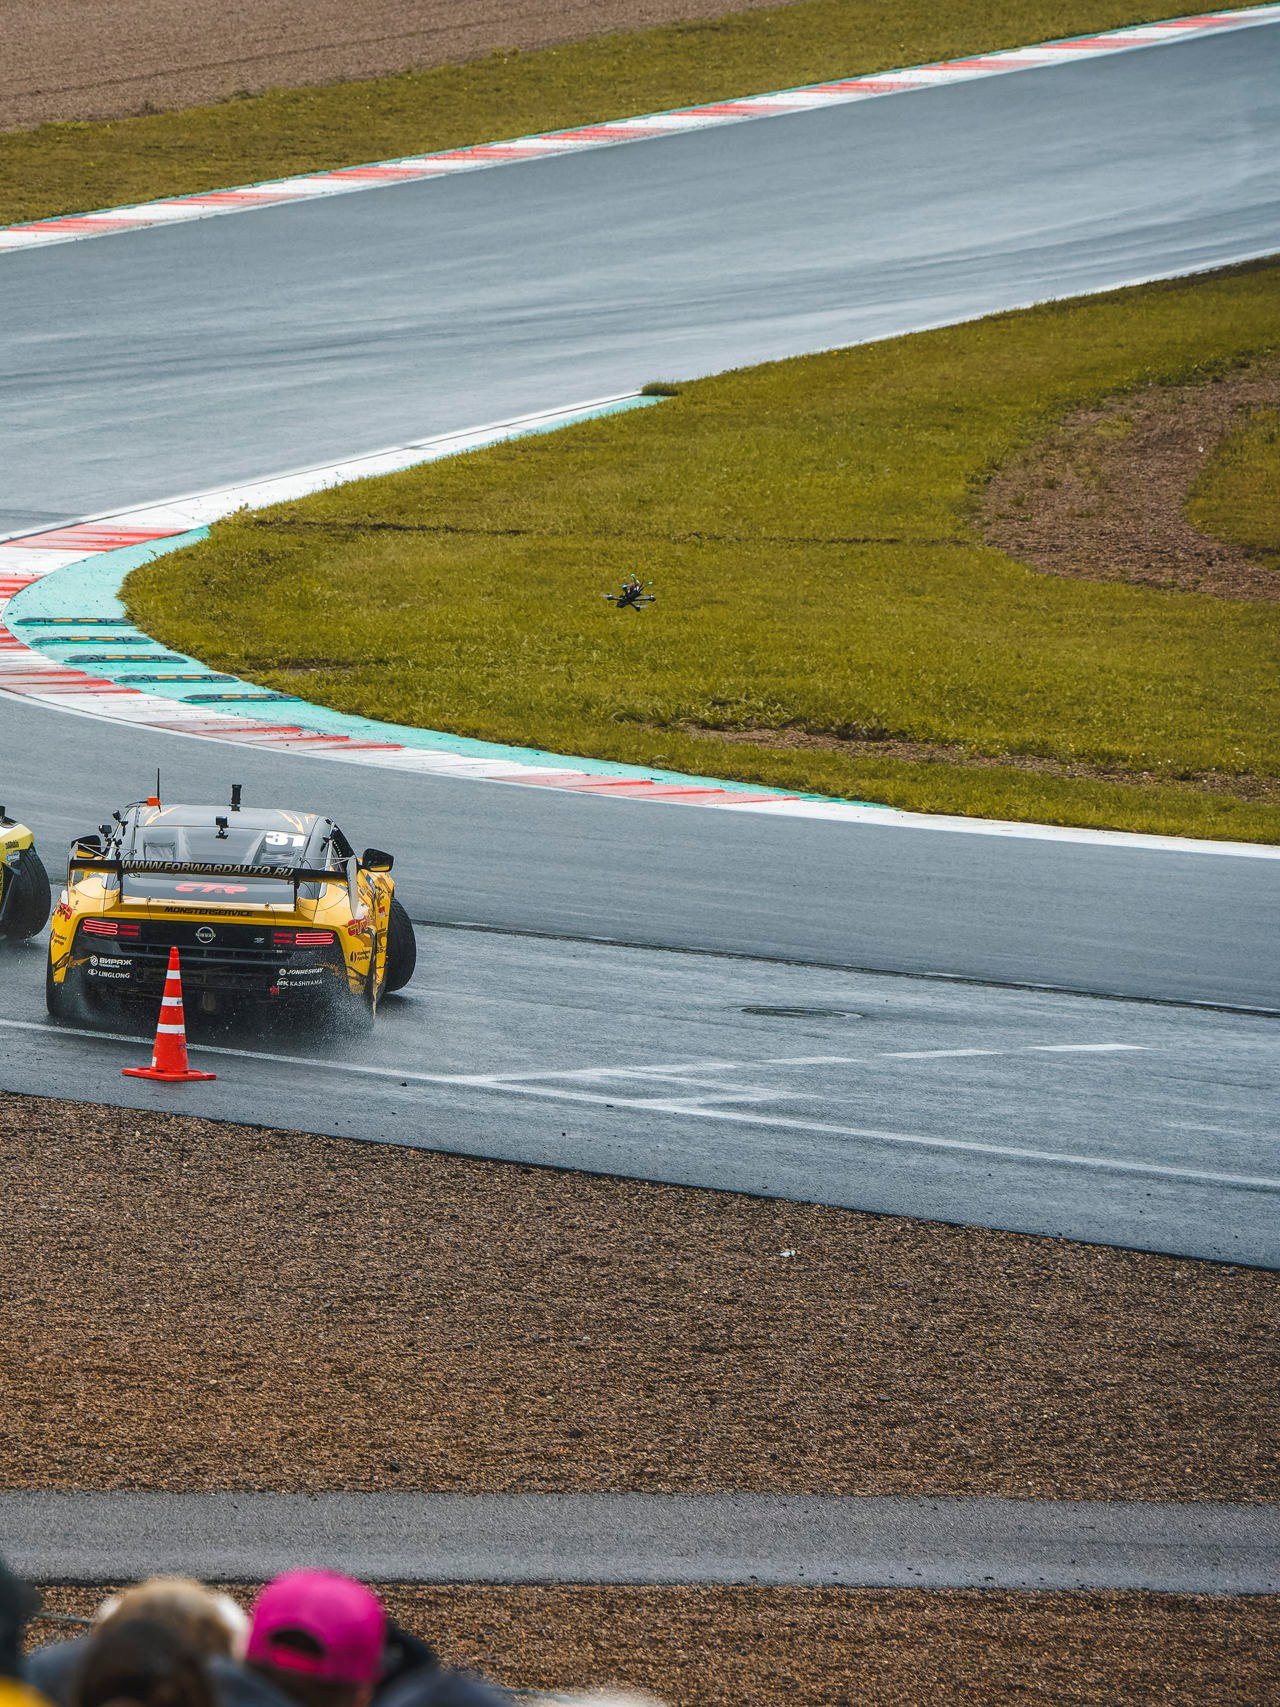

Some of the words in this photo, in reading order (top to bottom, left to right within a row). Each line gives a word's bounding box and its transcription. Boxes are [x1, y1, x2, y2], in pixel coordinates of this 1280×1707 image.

[122, 860, 294, 877] WWW.FORWARDAUTO.RU
[99, 957, 132, 966] ВИРАЖ
[98, 970, 131, 979] LINGLONG
[289, 979, 323, 987] KASHIYAMA
